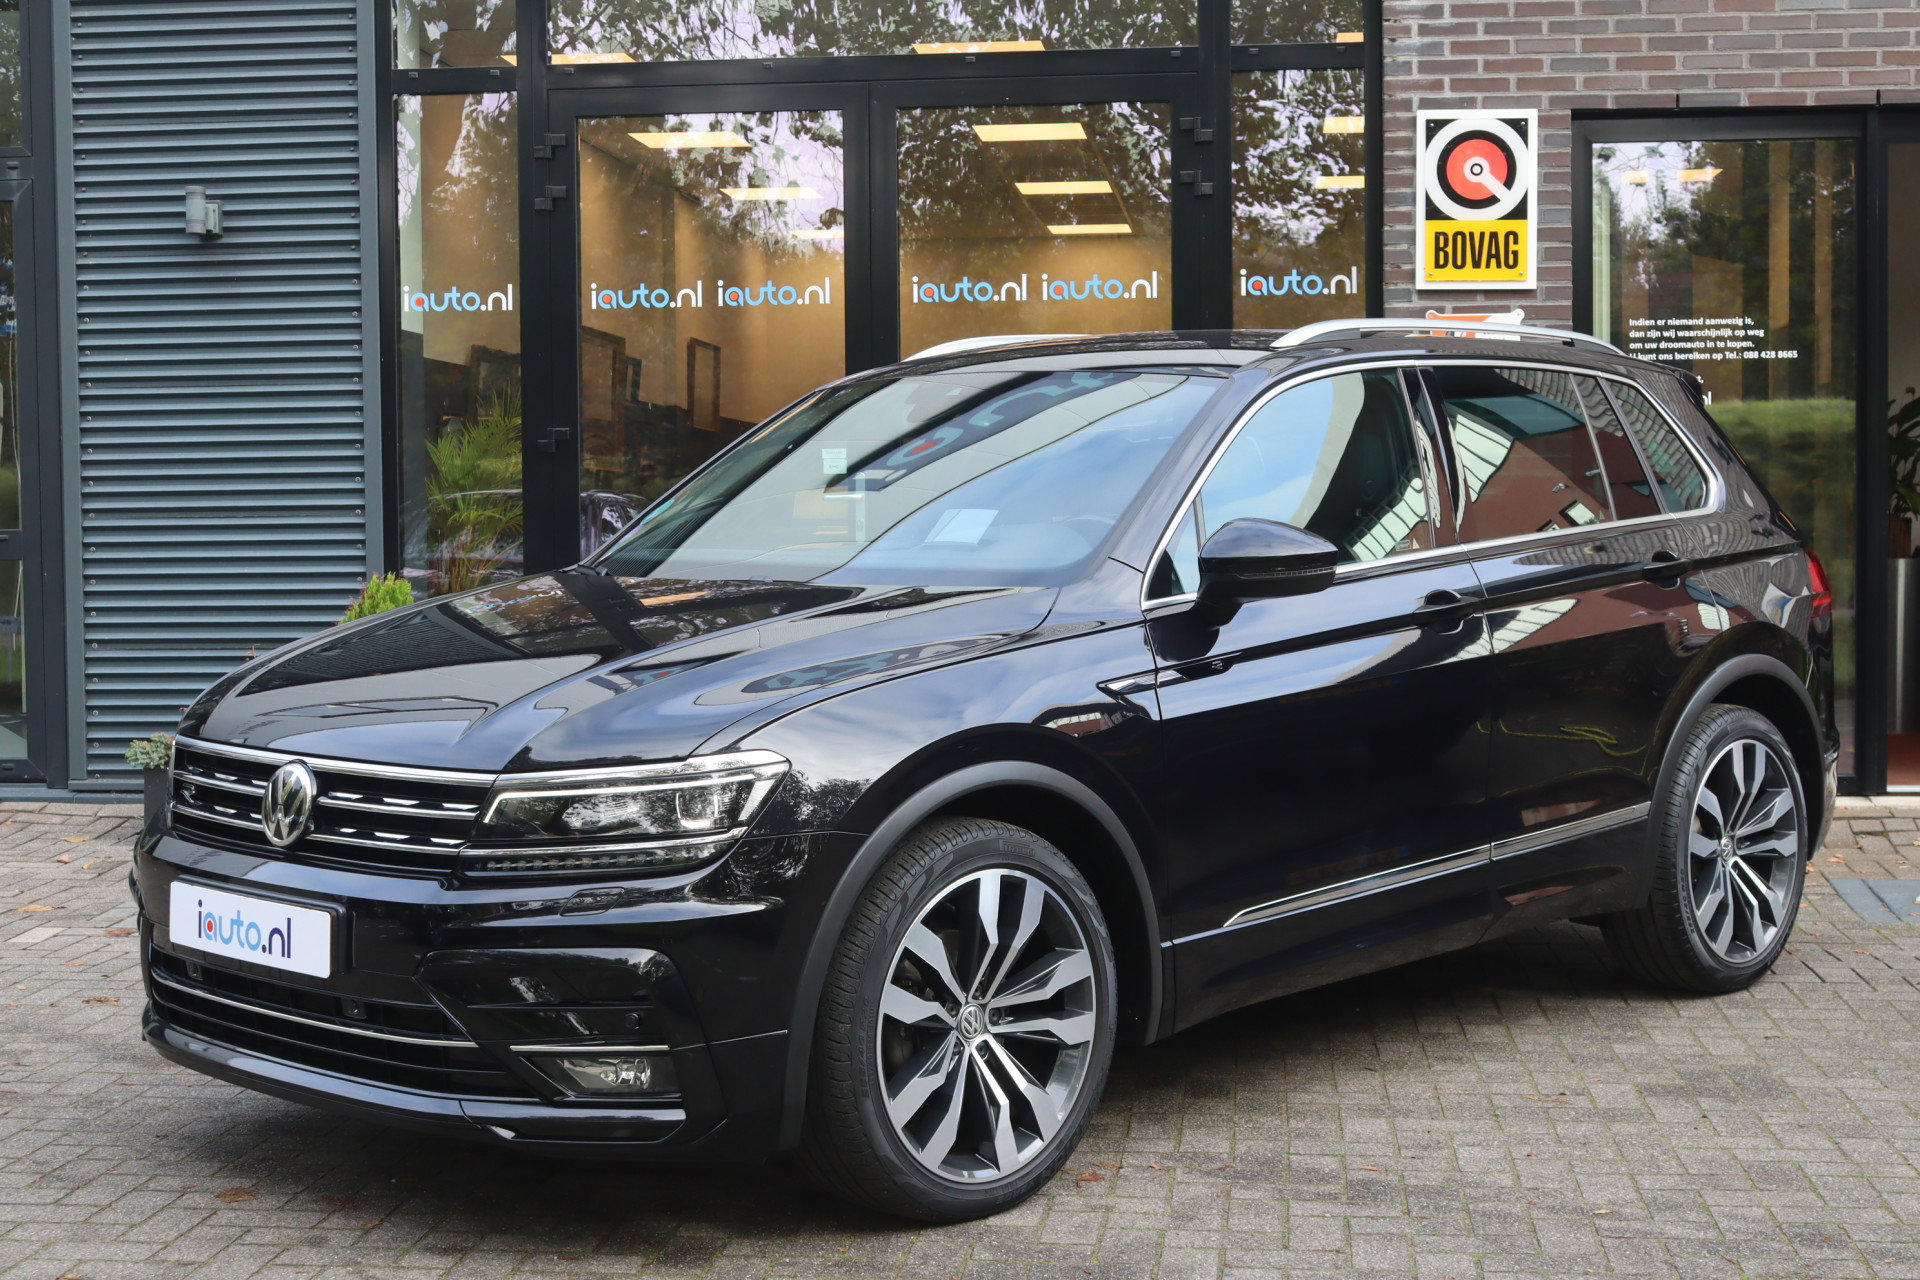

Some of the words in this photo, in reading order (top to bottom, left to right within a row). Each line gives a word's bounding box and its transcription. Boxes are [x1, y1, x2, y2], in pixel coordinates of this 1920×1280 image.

[1434, 230, 1519, 270] BOVAG
[591, 280, 702, 310] iauto.nl
[717, 277, 831, 307] iauto.nl
[912, 273, 1027, 303] iauto.nl
[1042, 270, 1158, 301] iauto.nl
[1240, 266, 1358, 297] iauto.nl
[402, 283, 513, 312] iauto.nl
[1629, 318, 1656, 327] Indien
[1667, 317, 1703, 326] niemand
[1705, 317, 1743, 327] aanwezig
[1745, 316, 1755, 326] is,
[1629, 329, 1645, 338] dan
[1647, 329, 1661, 338] zijn
[1662, 329, 1676, 339] wij
[1677, 328, 1733, 338] waarschijnlijk
[1734, 329, 1746, 338] op
[1747, 329, 1765, 338] weg
[1659, 340, 1705, 349] droomauto
[1707, 340, 1715, 348] in
[1727, 339, 1755, 349] kopen.
[1675, 351, 1711, 360] bereiken
[1712, 352, 1723, 361] op
[1725, 350, 1742, 360] Tel.:
[1743, 351, 1759, 359] 088
[1760, 350, 1776, 359] 428
[1777, 350, 1798, 359] 8665
[198, 899, 292, 959] iauto.nl
